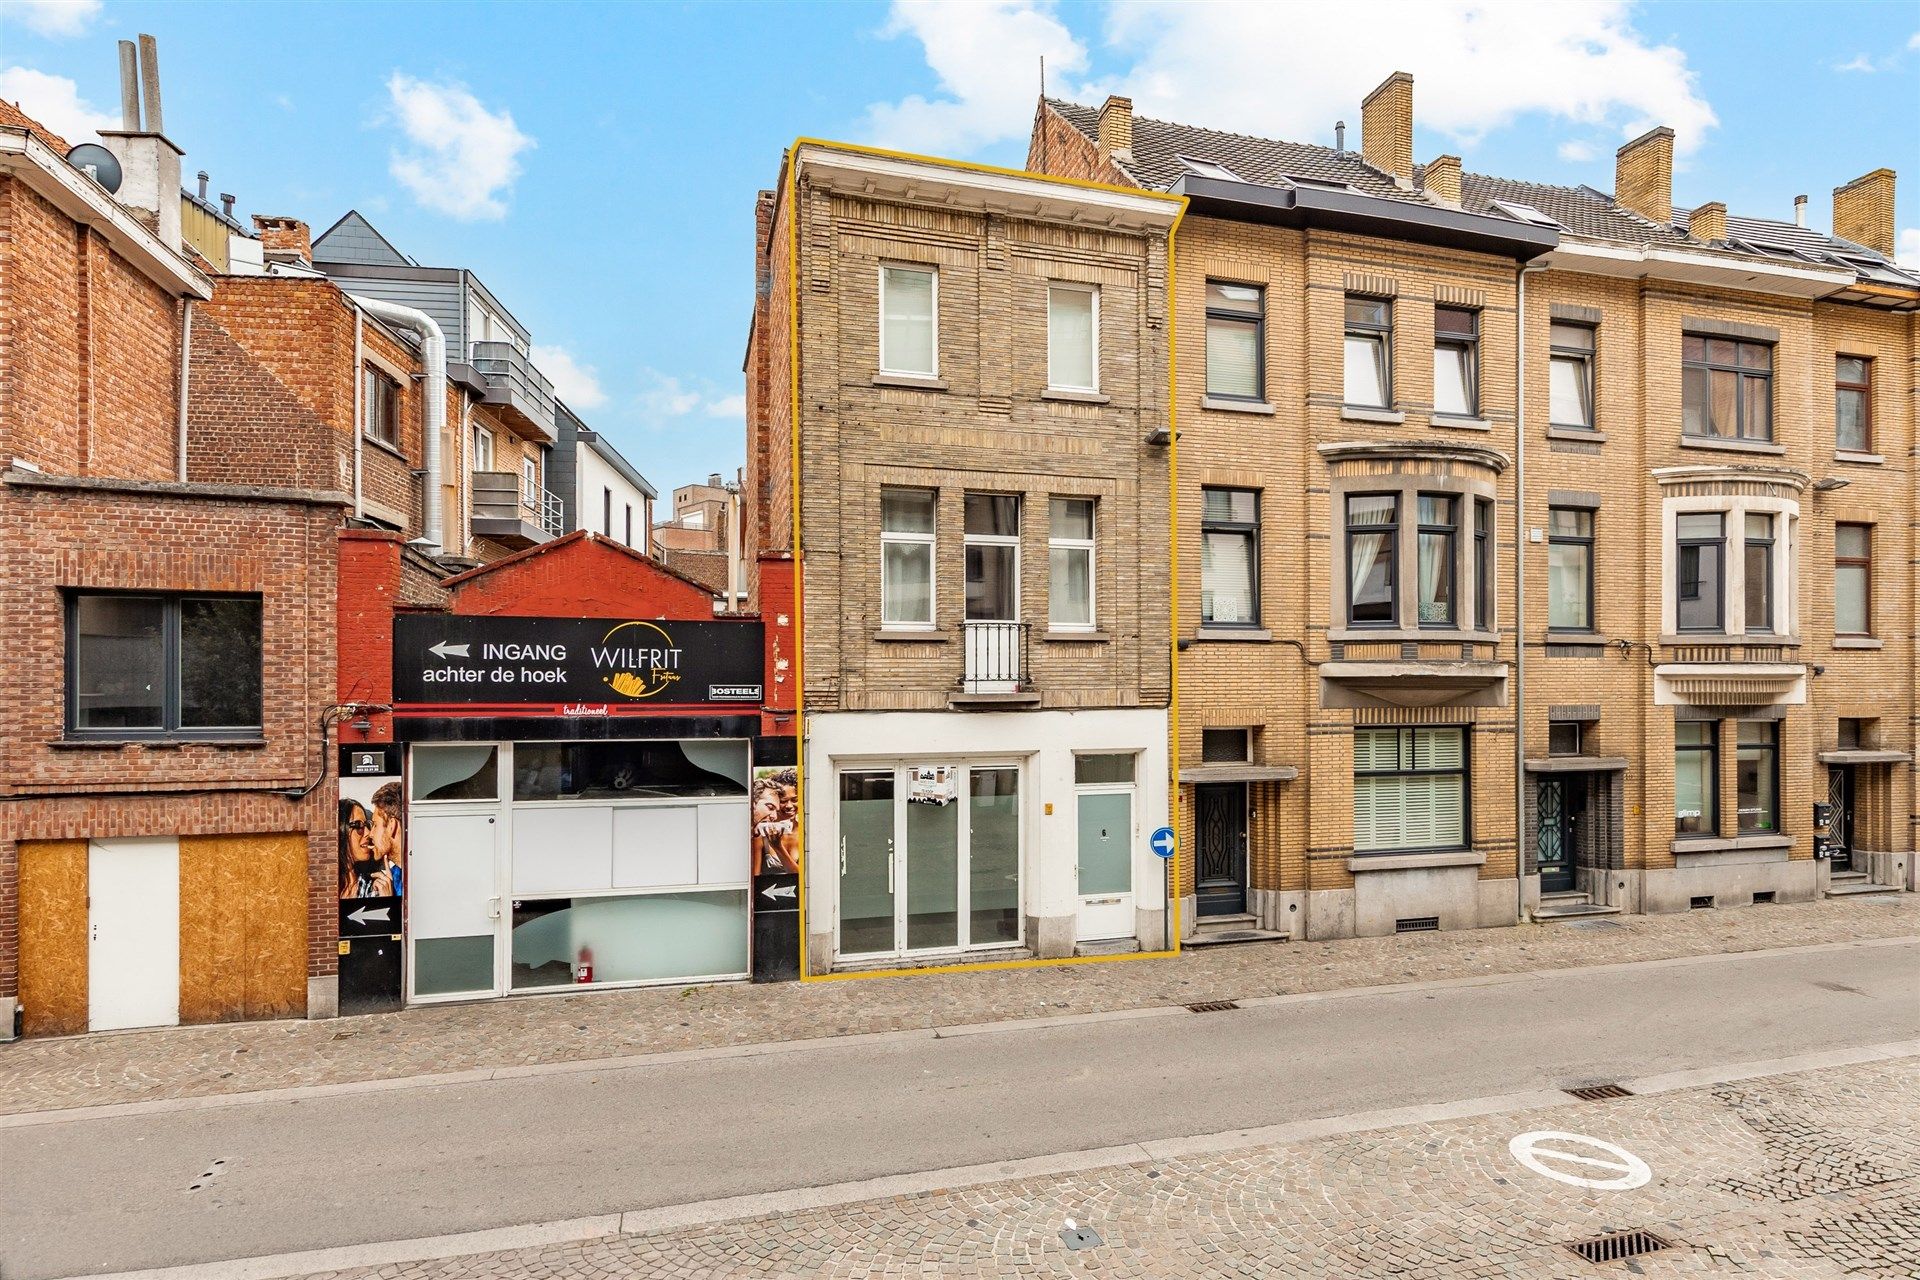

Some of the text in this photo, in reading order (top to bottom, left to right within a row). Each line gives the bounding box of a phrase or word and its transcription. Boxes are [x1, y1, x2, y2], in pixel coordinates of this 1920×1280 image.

[482, 643, 567, 661] INGANG
[590, 647, 682, 669] WILFRIT
[422, 666, 567, 683] achter de hoek
[563, 703, 608, 716] traditioneel
